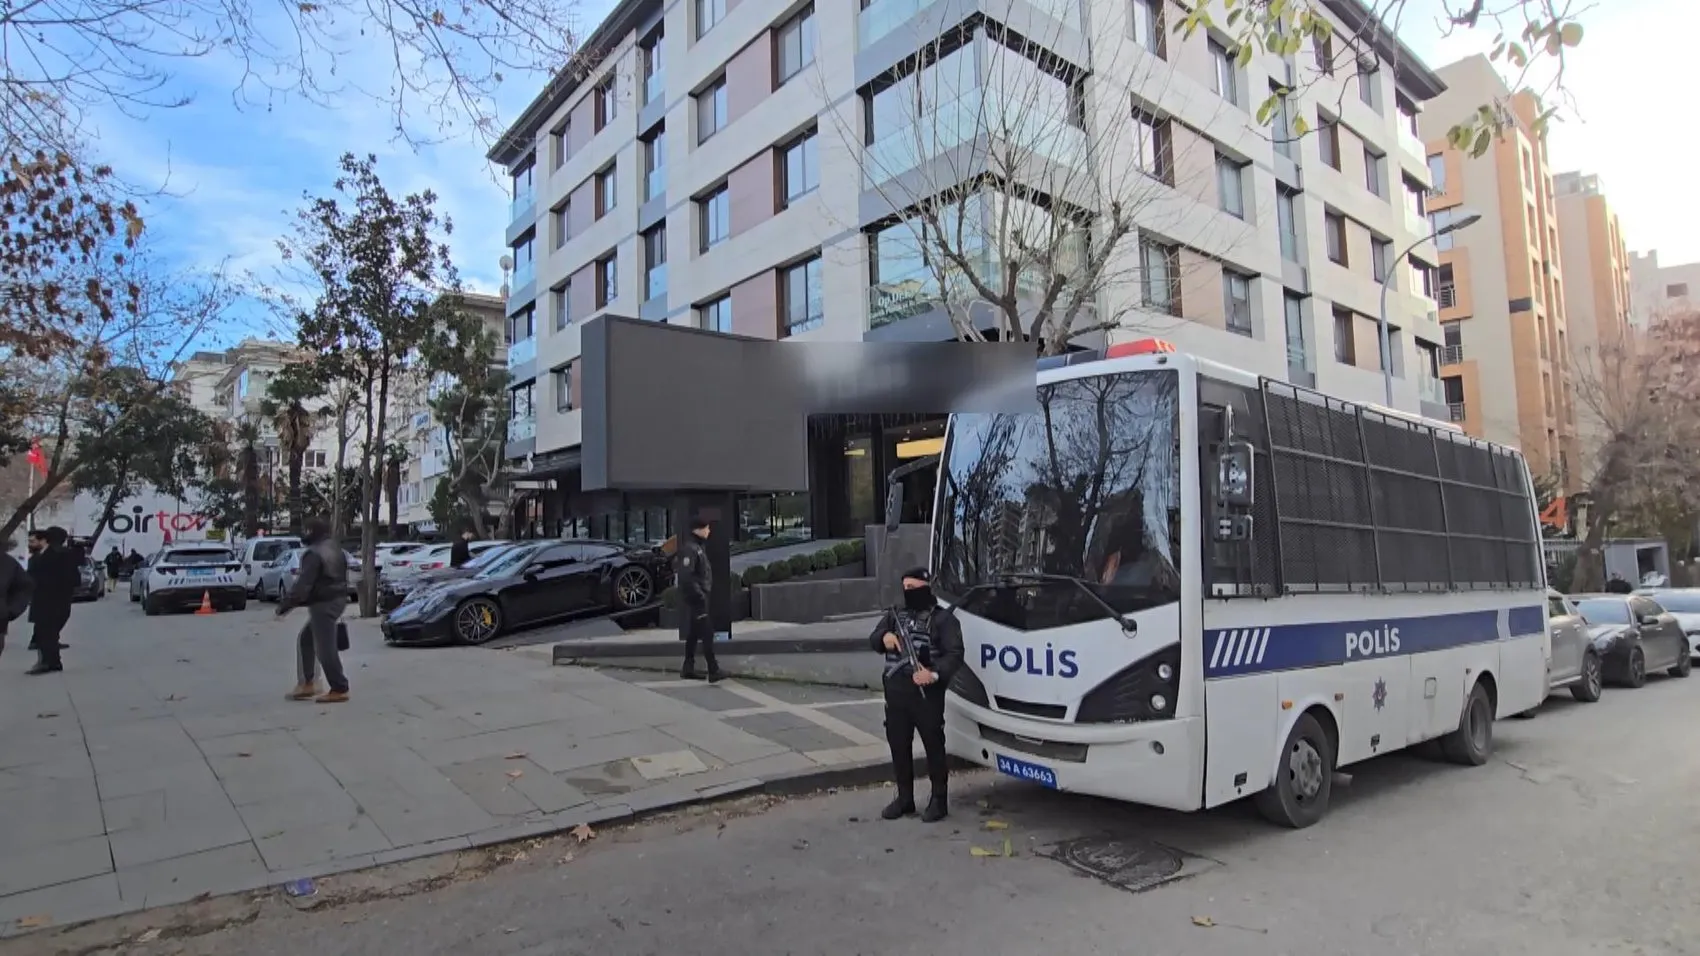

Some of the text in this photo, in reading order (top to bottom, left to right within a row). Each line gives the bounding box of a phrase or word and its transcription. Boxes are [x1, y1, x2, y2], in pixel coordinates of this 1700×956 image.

[1345, 623, 1401, 658] POLİS
[980, 642, 1079, 679] POLİS
[999, 758, 1053, 783] 34 A 63663
